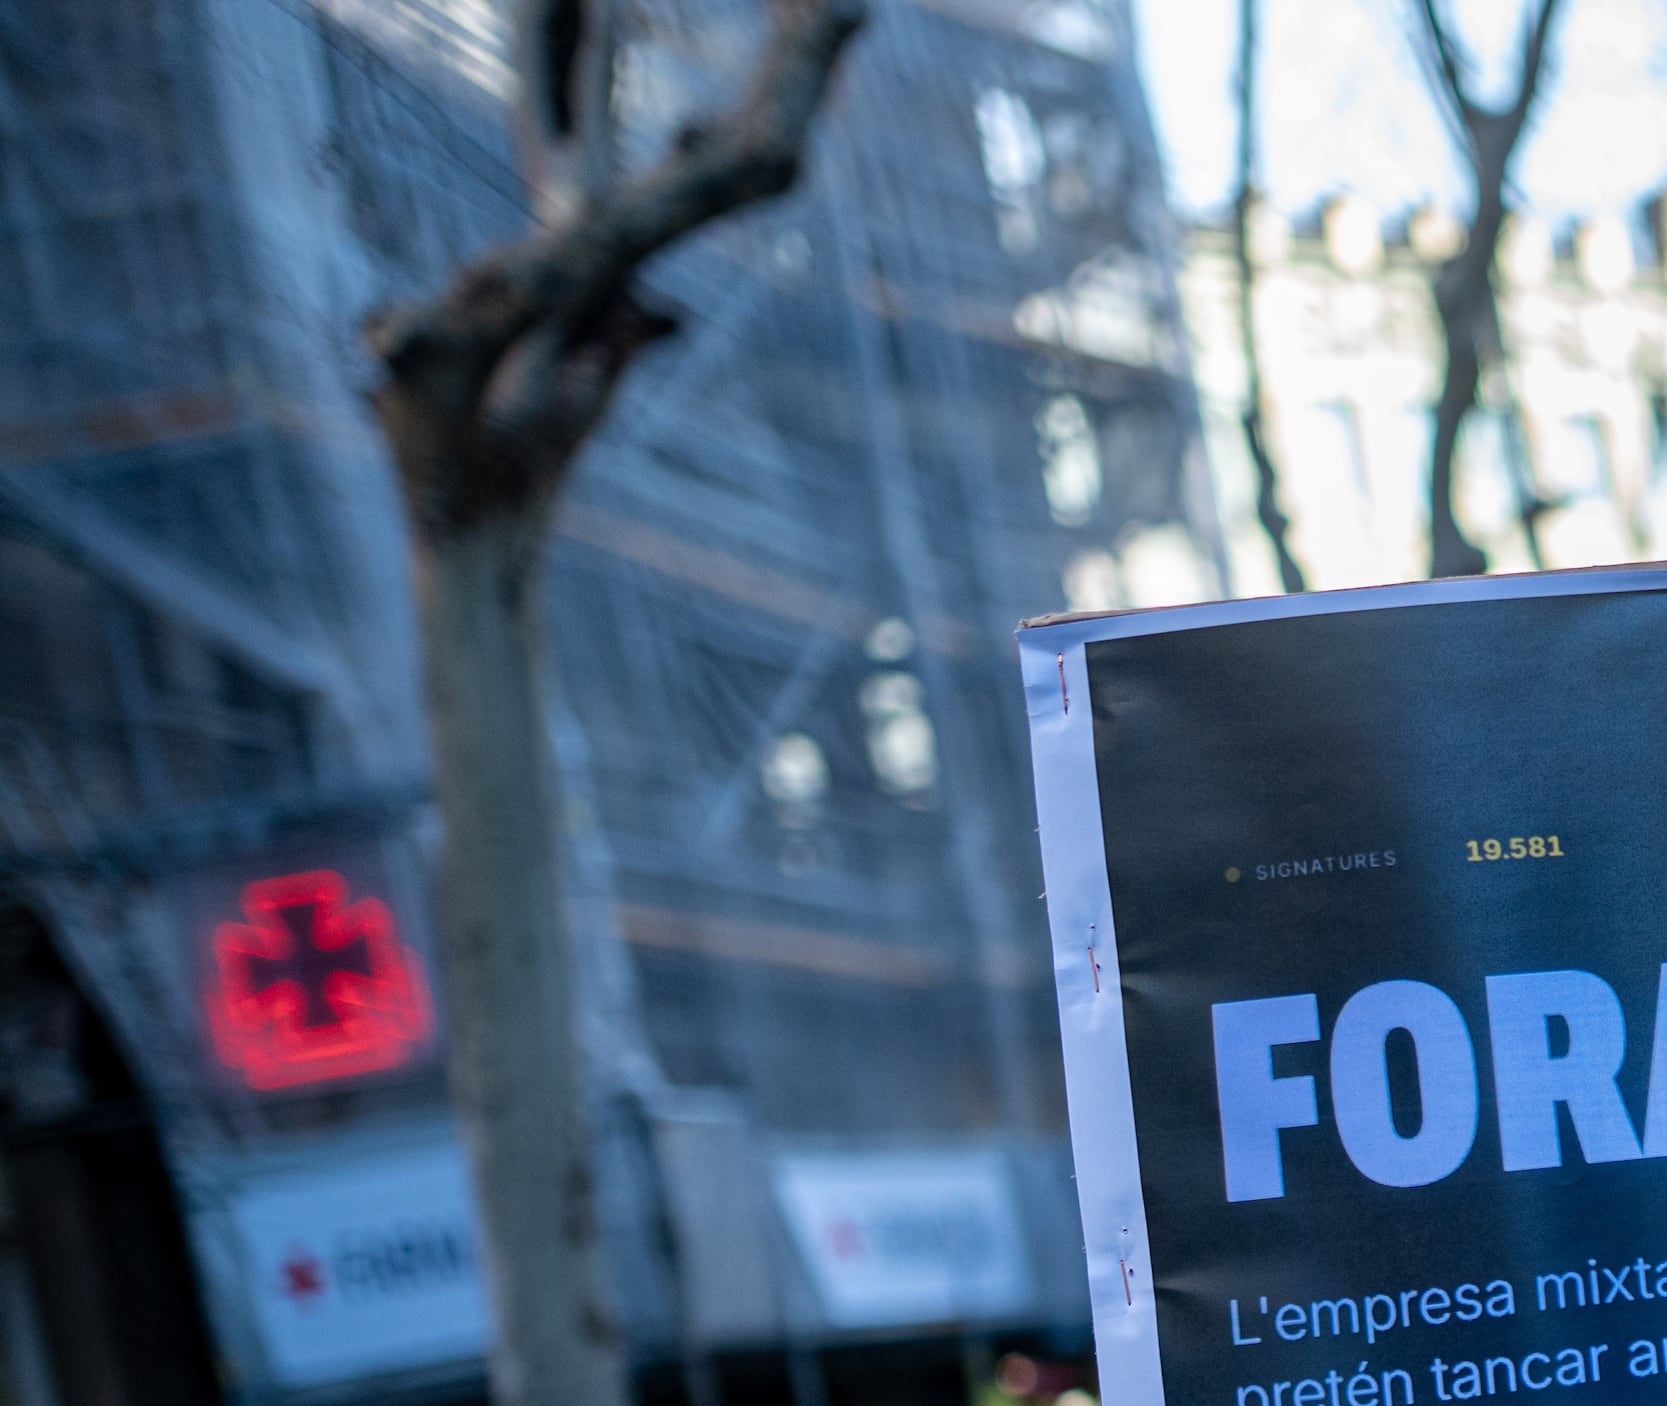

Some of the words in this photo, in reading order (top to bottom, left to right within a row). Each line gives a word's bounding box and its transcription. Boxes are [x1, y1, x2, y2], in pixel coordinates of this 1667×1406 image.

[1255, 850, 1398, 881] SIGNATURES
[1466, 835, 1565, 863] 19.581
[1228, 1278, 1516, 1346] L'empresa
[1430, 1344, 1607, 1401] tancar
